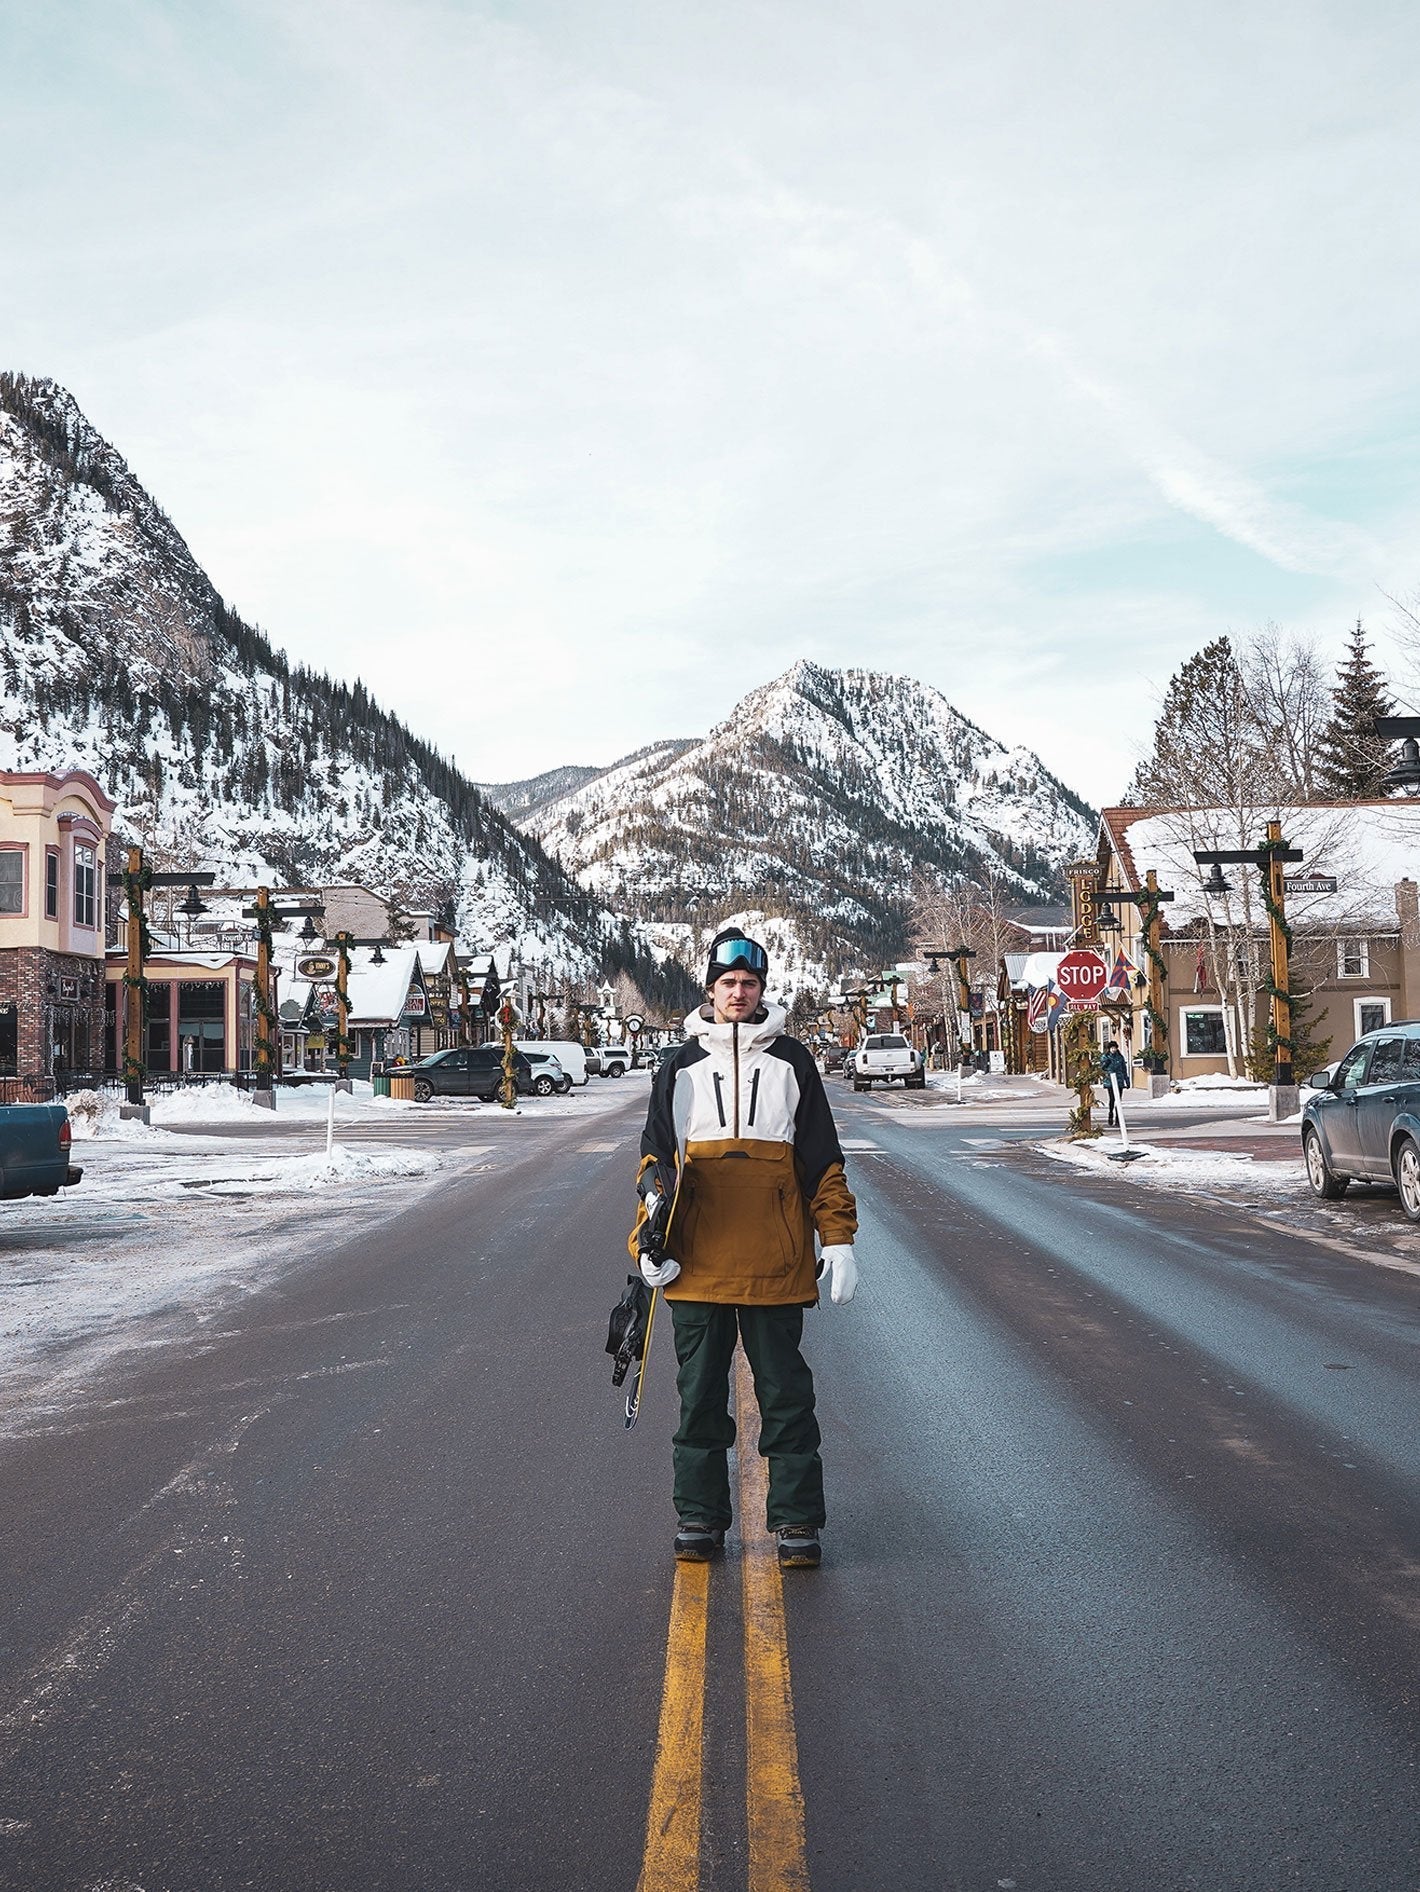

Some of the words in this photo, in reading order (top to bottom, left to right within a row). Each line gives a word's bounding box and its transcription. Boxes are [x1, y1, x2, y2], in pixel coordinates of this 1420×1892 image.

[1286, 881, 1315, 891] Fourth
[1316, 882, 1331, 891] Ave
[1079, 879, 1092, 939] LODGE
[222, 932, 243, 941] Fourth
[244, 933, 253, 941] Av
[1060, 966, 1104, 985] STOP
